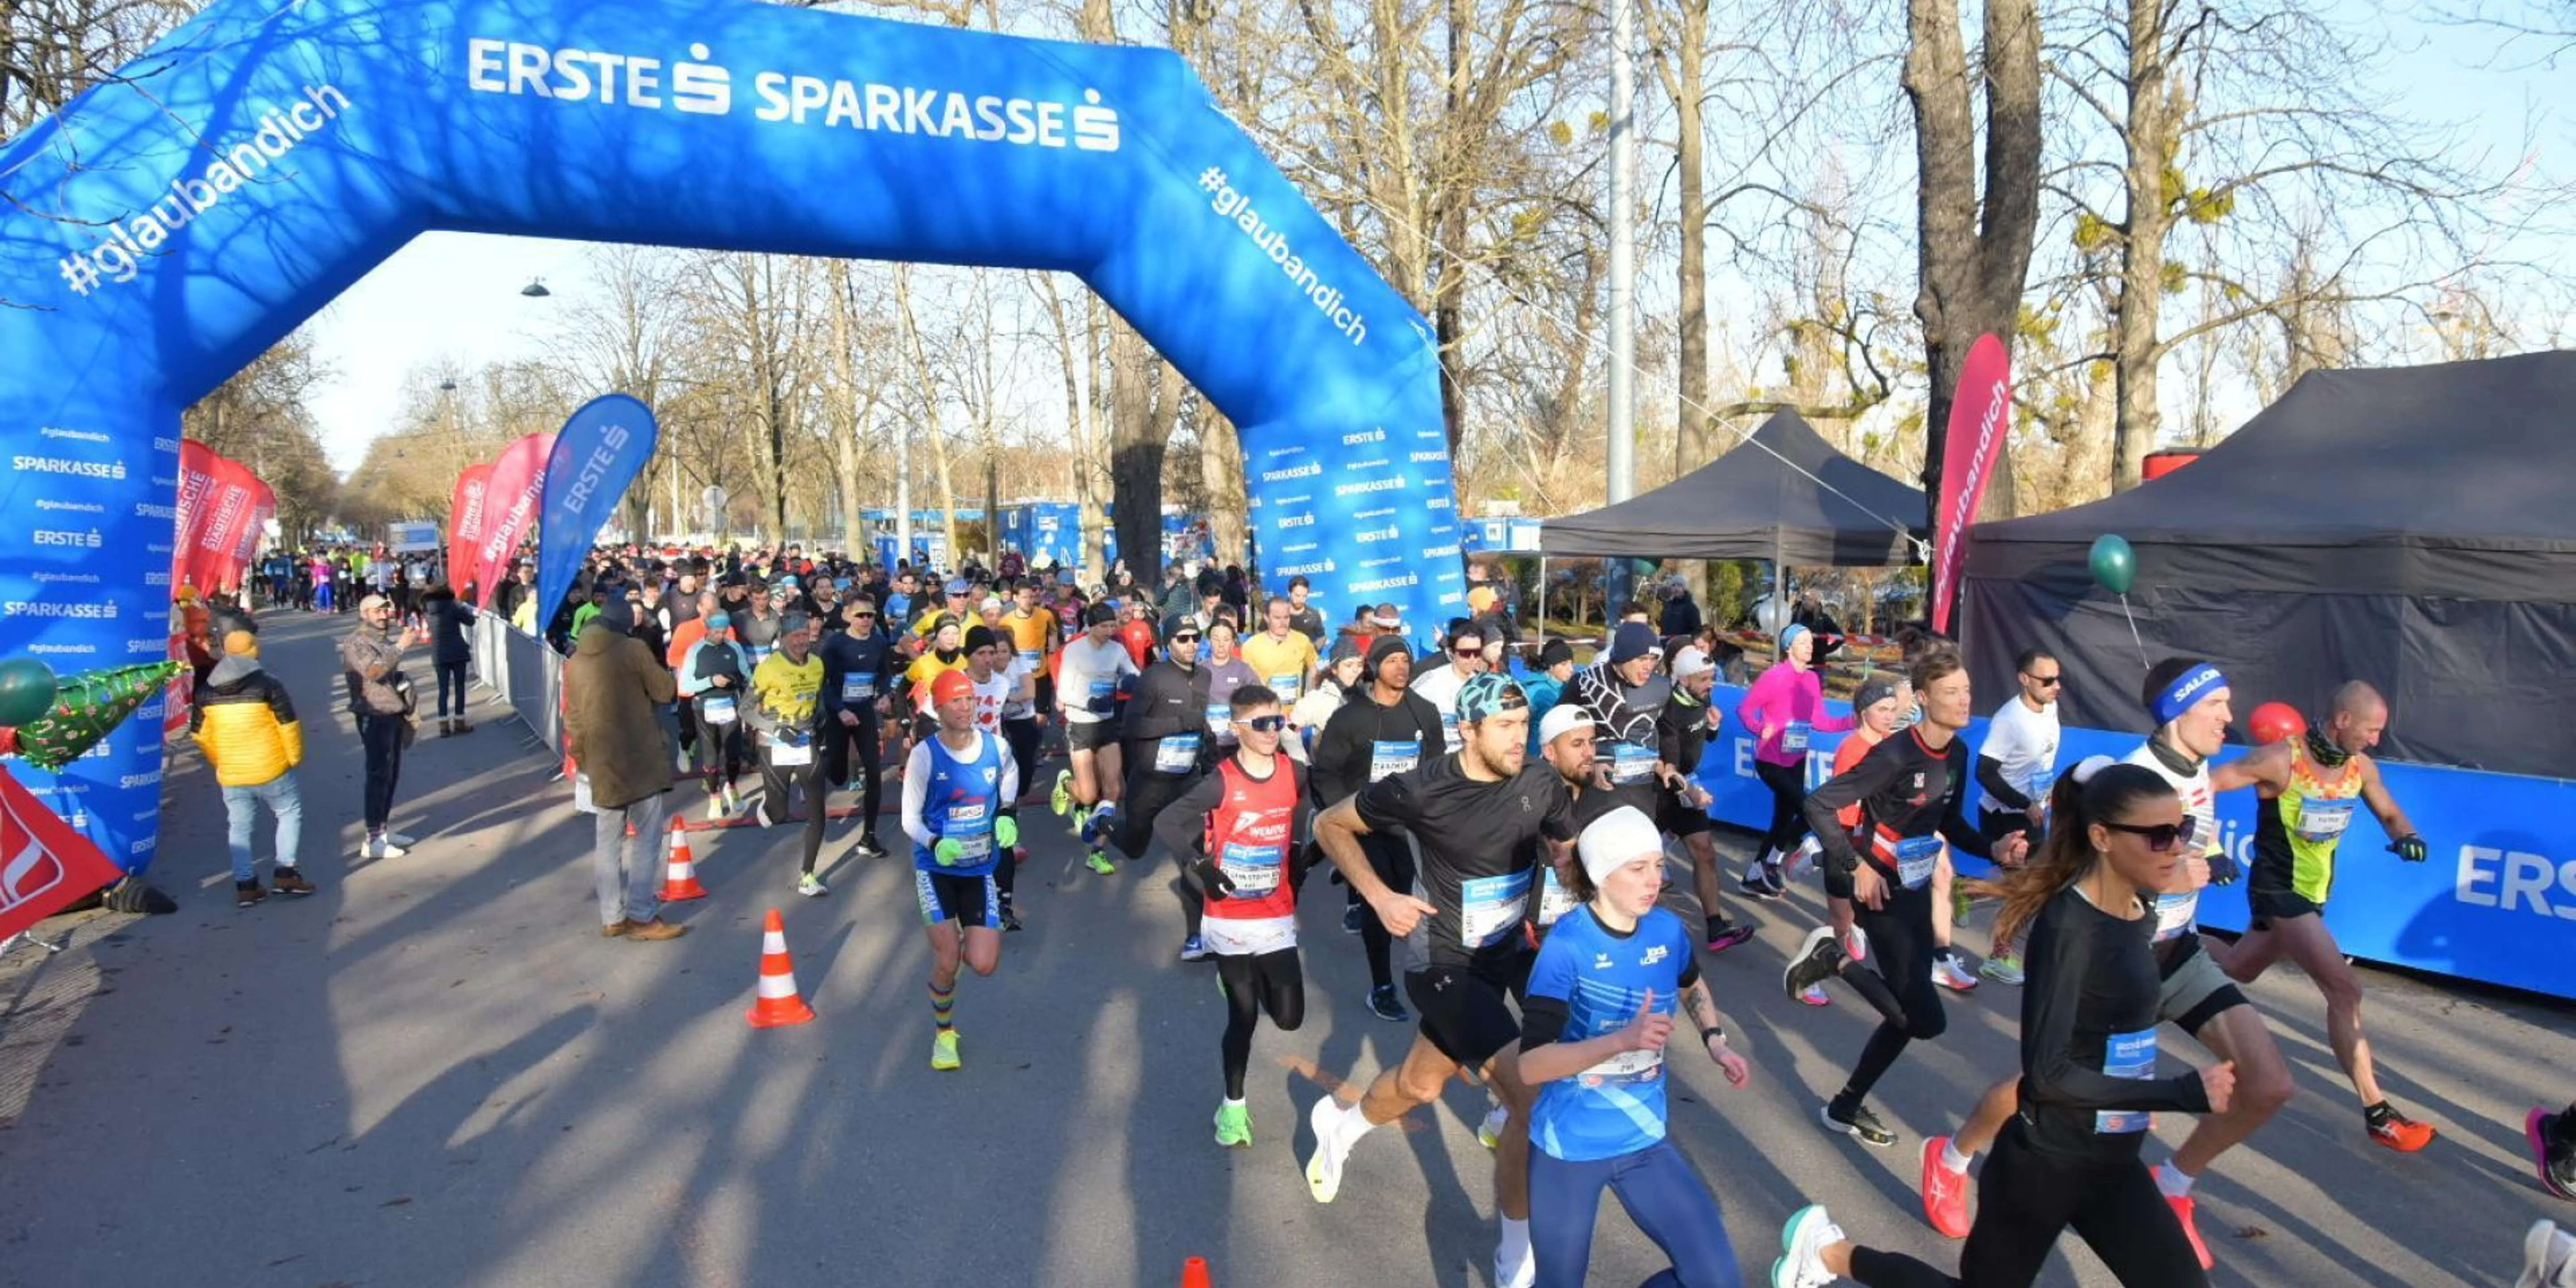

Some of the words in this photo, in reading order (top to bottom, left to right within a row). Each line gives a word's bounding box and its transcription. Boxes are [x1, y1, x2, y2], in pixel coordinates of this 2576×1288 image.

[469, 38, 661, 109] ERSTE
[754, 71, 1066, 148] SPARKASSE
[59, 85, 351, 296] #glaubandich
[1198, 166, 1367, 346] #glaubandich
[13, 456, 110, 478] SPARKASSE
[563, 449, 614, 514] ERSTE
[34, 530, 85, 547] ERSTE
[4, 601, 102, 619] SPARKASSE
